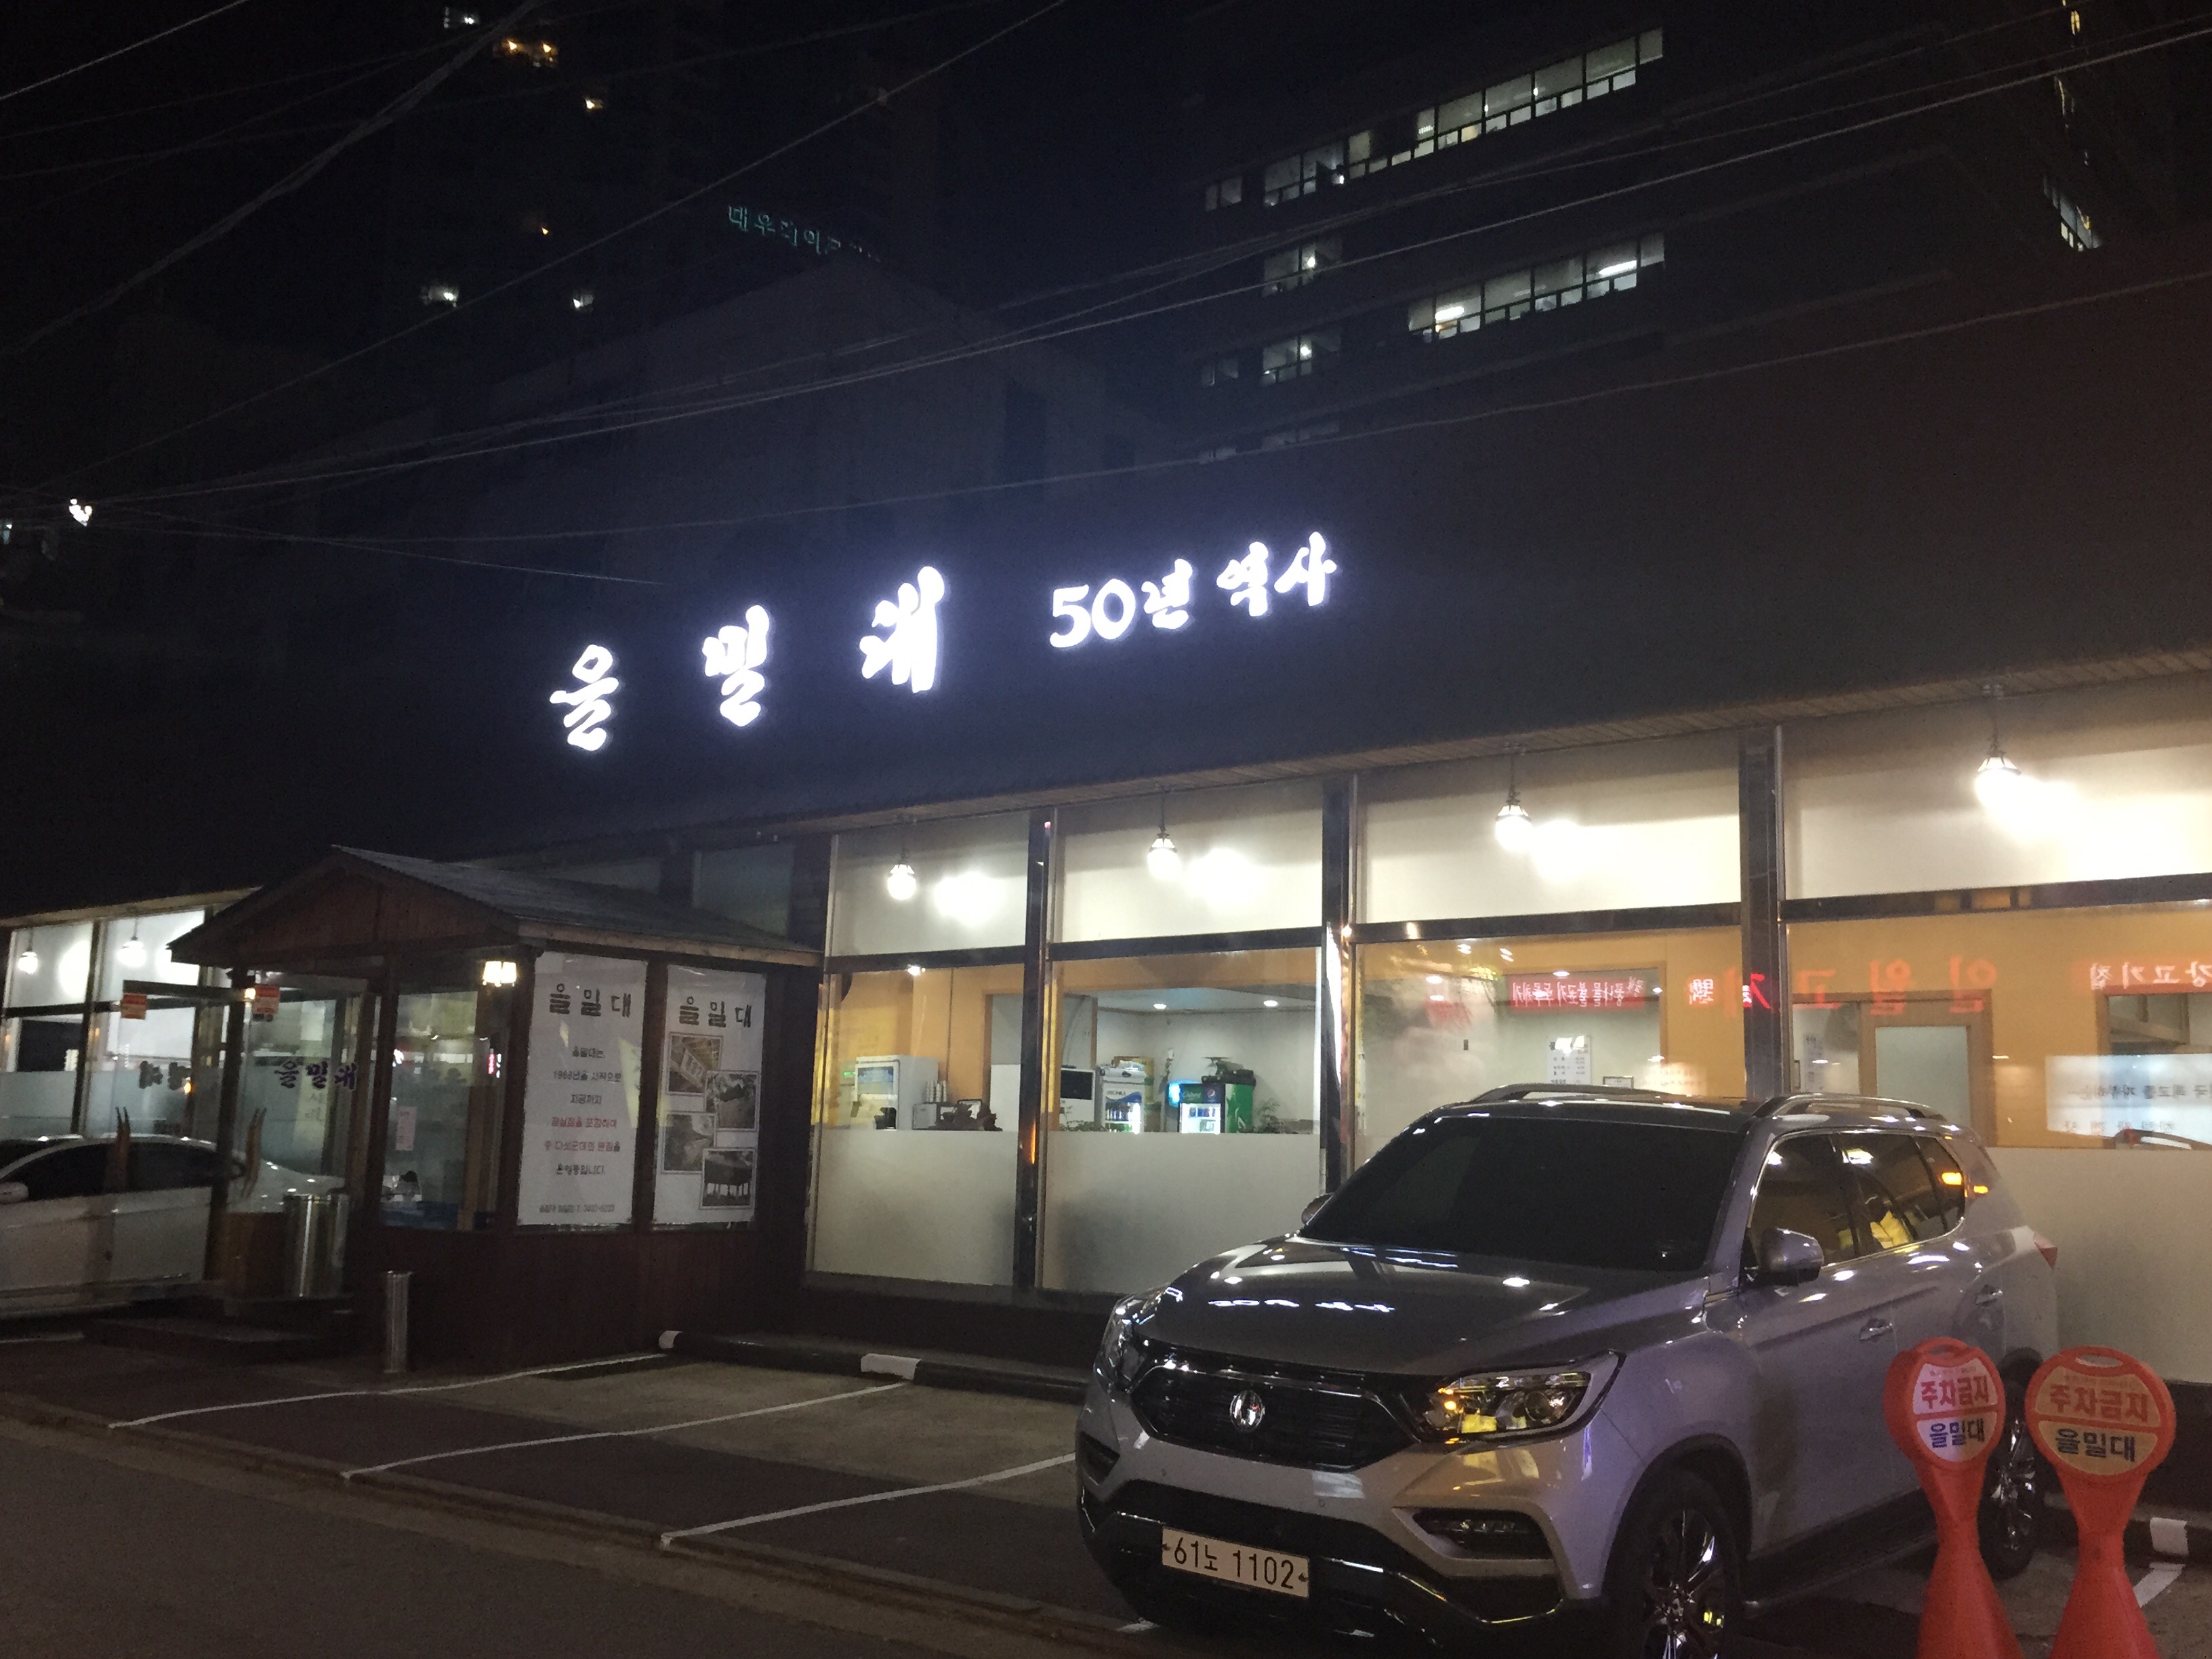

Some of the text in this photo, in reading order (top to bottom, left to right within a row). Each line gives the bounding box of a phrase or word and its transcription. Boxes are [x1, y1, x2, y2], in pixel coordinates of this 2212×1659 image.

[549, 531, 1337, 752] 을밀대 50년 역사
[1921, 1375, 1989, 1410] 주차금지
[2049, 1384, 2149, 1422] 주차금지
[1929, 1418, 1986, 1449] 을밀대
[2054, 1427, 2137, 1462] 을밀대
[1174, 1537, 1294, 1590] 61노 1102
